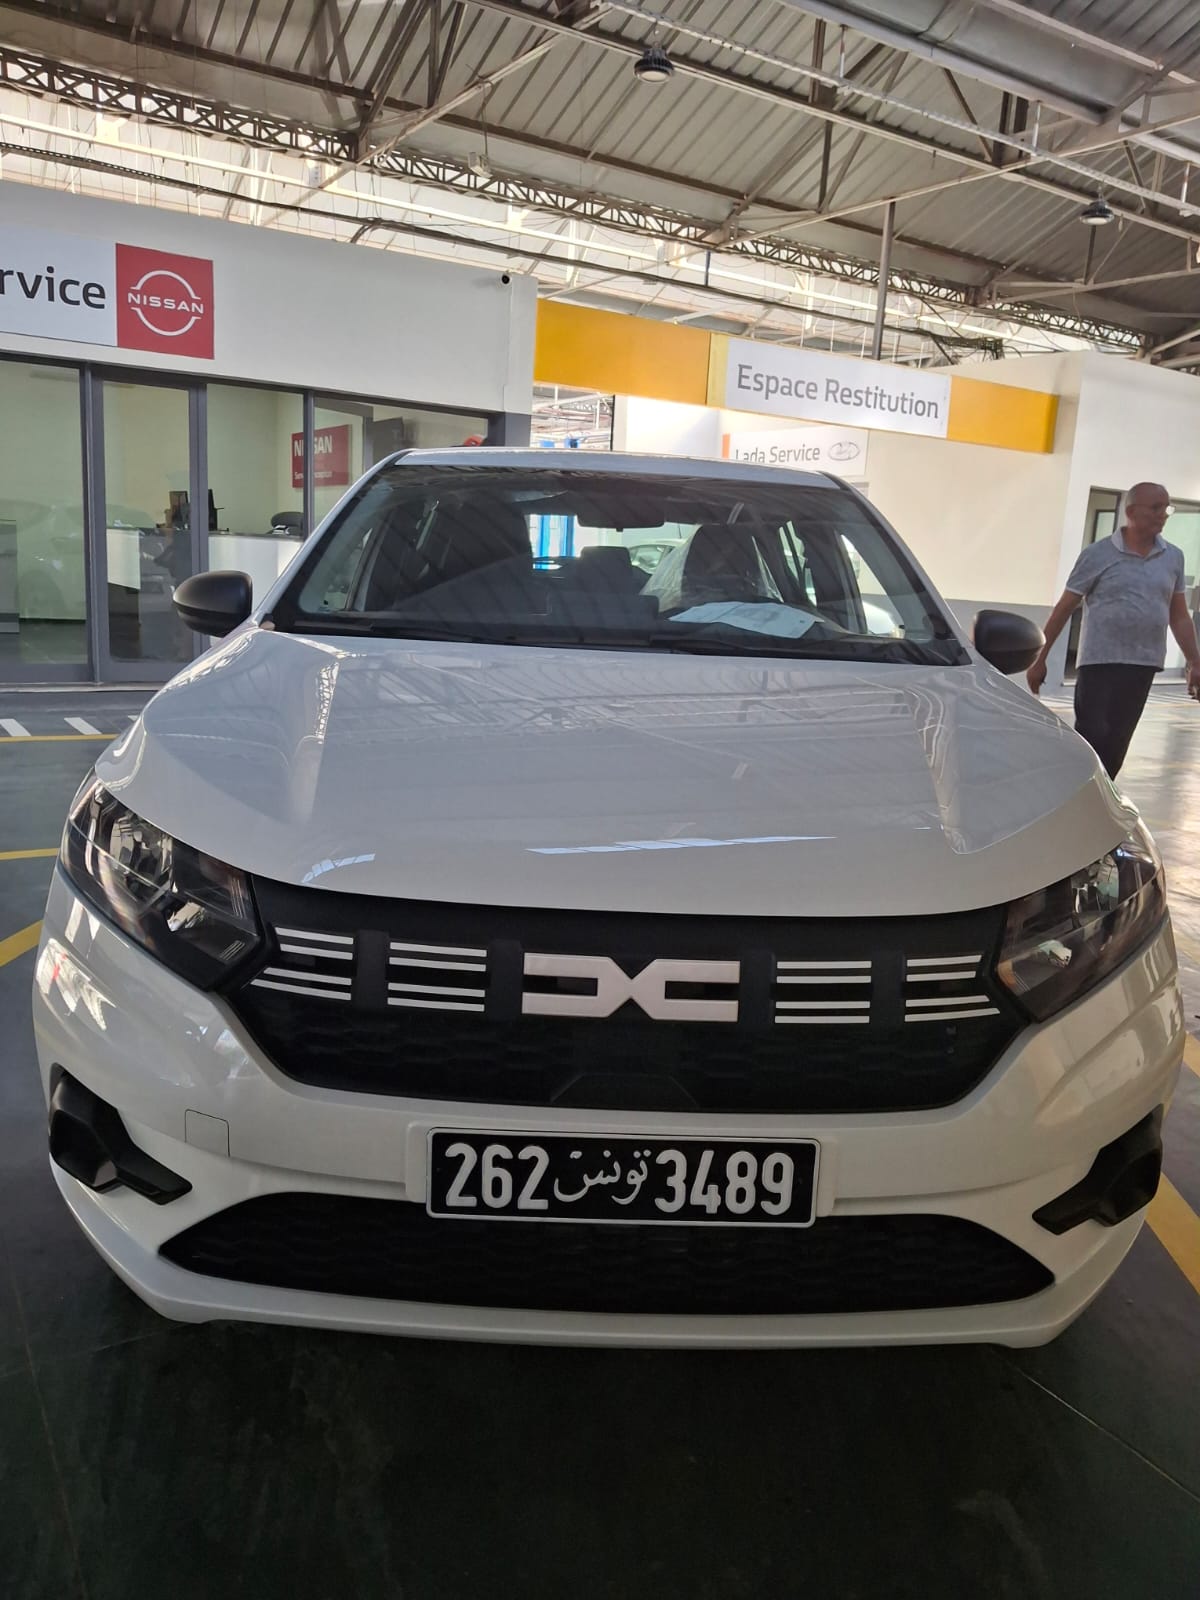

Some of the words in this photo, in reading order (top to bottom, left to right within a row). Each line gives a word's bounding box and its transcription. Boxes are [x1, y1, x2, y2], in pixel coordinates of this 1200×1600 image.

[128, 292, 204, 314] NISSAN
[737, 364, 818, 400] Espace
[825, 377, 939, 419] Restitution
[769, 443, 821, 463] Service
[445, 1142, 550, 1211] 262
[553, 1148, 651, 1206] تونس
[654, 1149, 795, 1216] 3489
